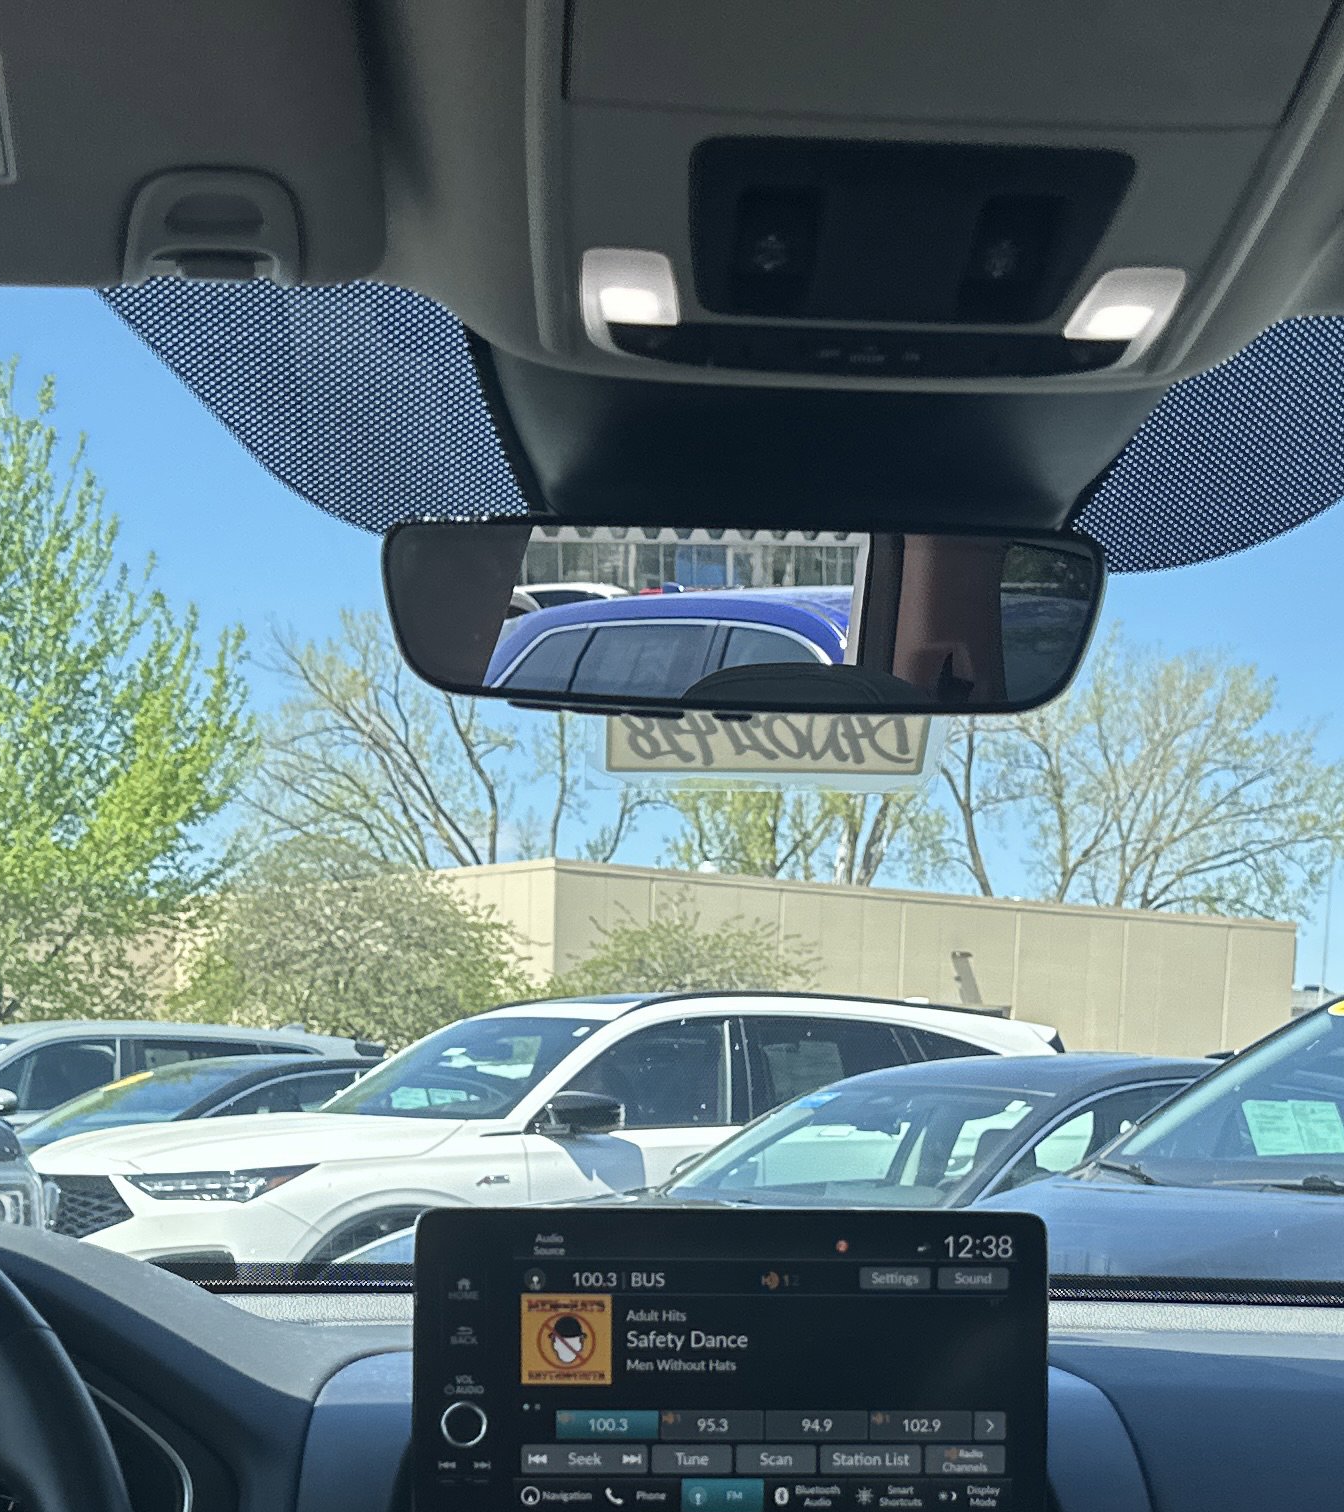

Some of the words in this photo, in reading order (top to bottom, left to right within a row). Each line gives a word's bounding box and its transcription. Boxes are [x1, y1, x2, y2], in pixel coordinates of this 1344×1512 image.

[535, 1233, 564, 1244] Audio
[943, 1235, 1013, 1259] 12:38
[572, 1271, 618, 1288] 100.3
[630, 1271, 666, 1287] BUS
[871, 1271, 919, 1287] Settings
[955, 1272, 993, 1286] Sound
[626, 1308, 659, 1322] Adult
[661, 1308, 687, 1322] Hits
[626, 1329, 685, 1352] Safety
[690, 1330, 749, 1349] Dance
[626, 1357, 655, 1372] Men
[656, 1357, 707, 1372] Without
[708, 1357, 737, 1372] Hats
[588, 1417, 629, 1433] 100.3
[696, 1417, 730, 1433] 95.3
[801, 1417, 834, 1433] 94.9
[902, 1417, 942, 1433] 102.9
[567, 1451, 603, 1467] Seek
[675, 1451, 710, 1467] Tune
[759, 1451, 793, 1467] Scan
[832, 1451, 882, 1467] Station
[884, 1451, 910, 1467] List
[726, 1489, 744, 1501] FM
